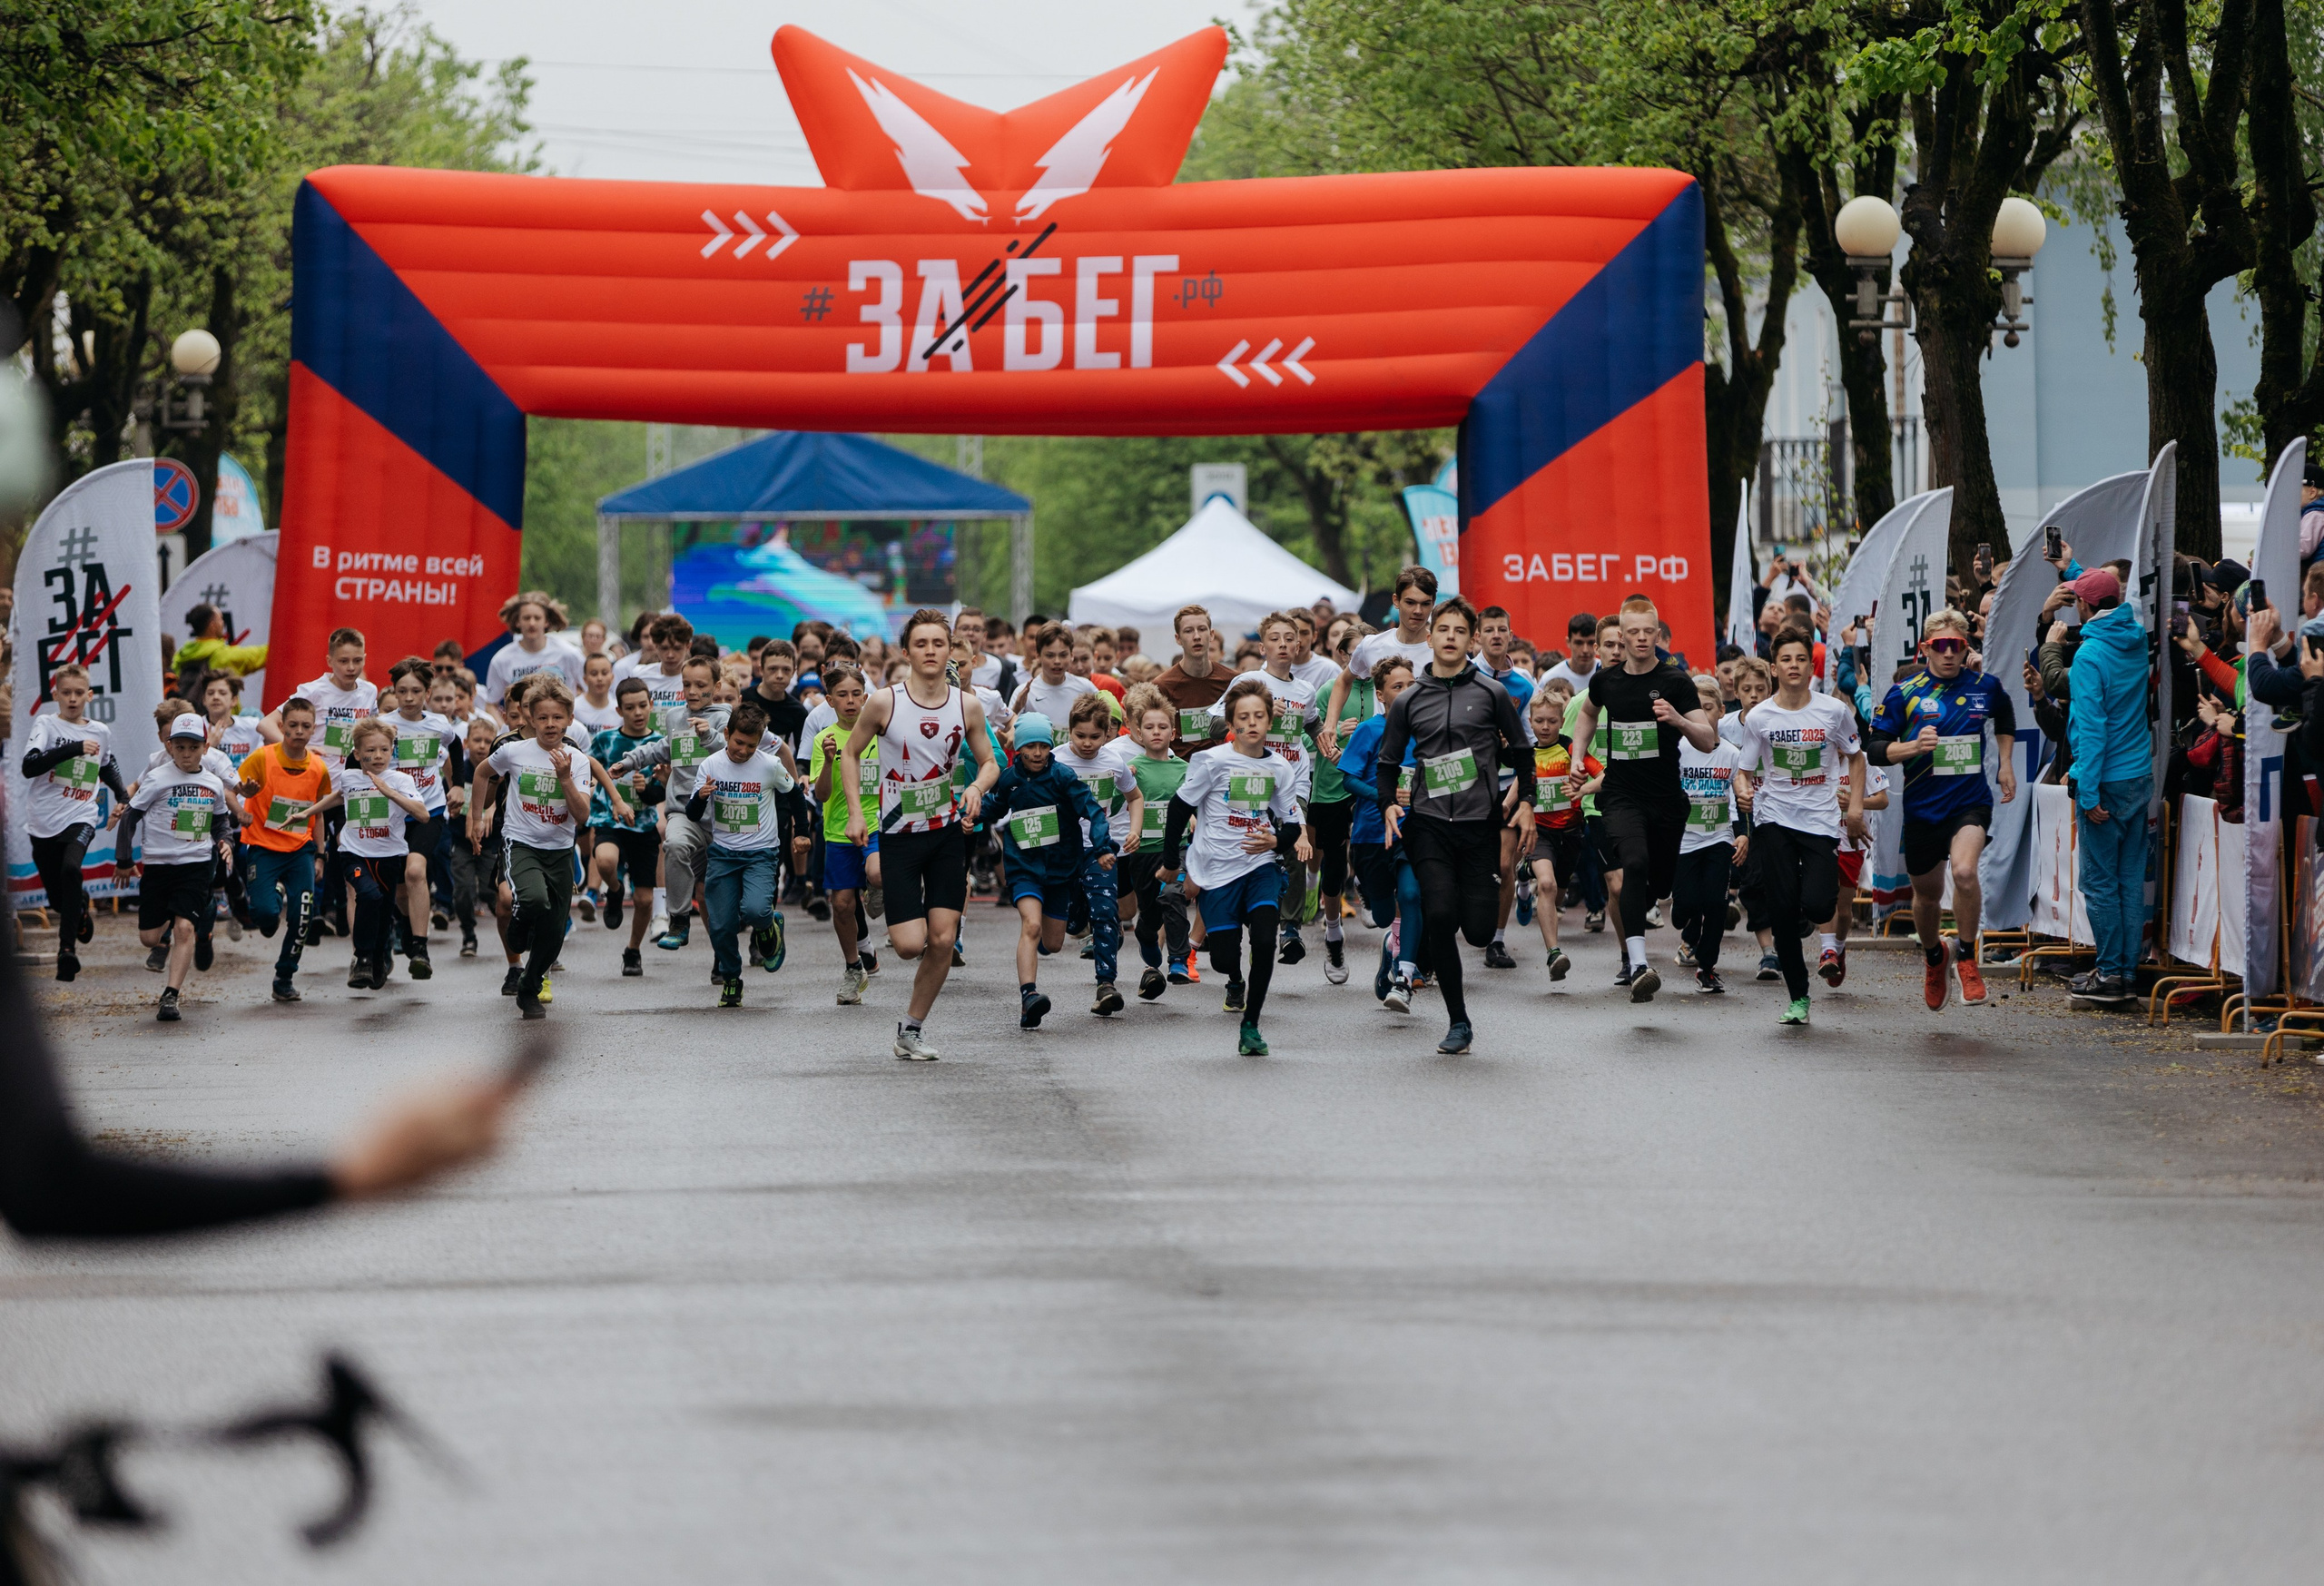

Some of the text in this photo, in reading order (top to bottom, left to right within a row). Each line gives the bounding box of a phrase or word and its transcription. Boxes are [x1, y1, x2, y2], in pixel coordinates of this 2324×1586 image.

[312, 545, 485, 577] В ритме всей
[335, 576, 458, 606] СТРАНЫ!
[1191, 714, 1210, 729] 205
[1281, 715, 1297, 731] 233
[1621, 730, 1643, 746] 223
[1769, 728, 1826, 744] #ЗАБЕГ2025
[412, 739, 430, 754] 357
[679, 738, 694, 754] 159
[1945, 744, 1973, 761] 2030
[1787, 750, 1807, 766] 220
[73, 760, 86, 776] 59
[1433, 760, 1465, 782] 2109
[534, 775, 556, 793] 366
[715, 781, 762, 793] #ЗАБЕГ2025
[1245, 778, 1266, 795] 480
[1539, 784, 1556, 800] 291
[914, 785, 941, 807] 2128
[358, 798, 370, 814] 10
[722, 803, 748, 821] 2079
[1700, 804, 1719, 820] 270
[192, 812, 208, 828] 351
[1023, 817, 1042, 834] 125
